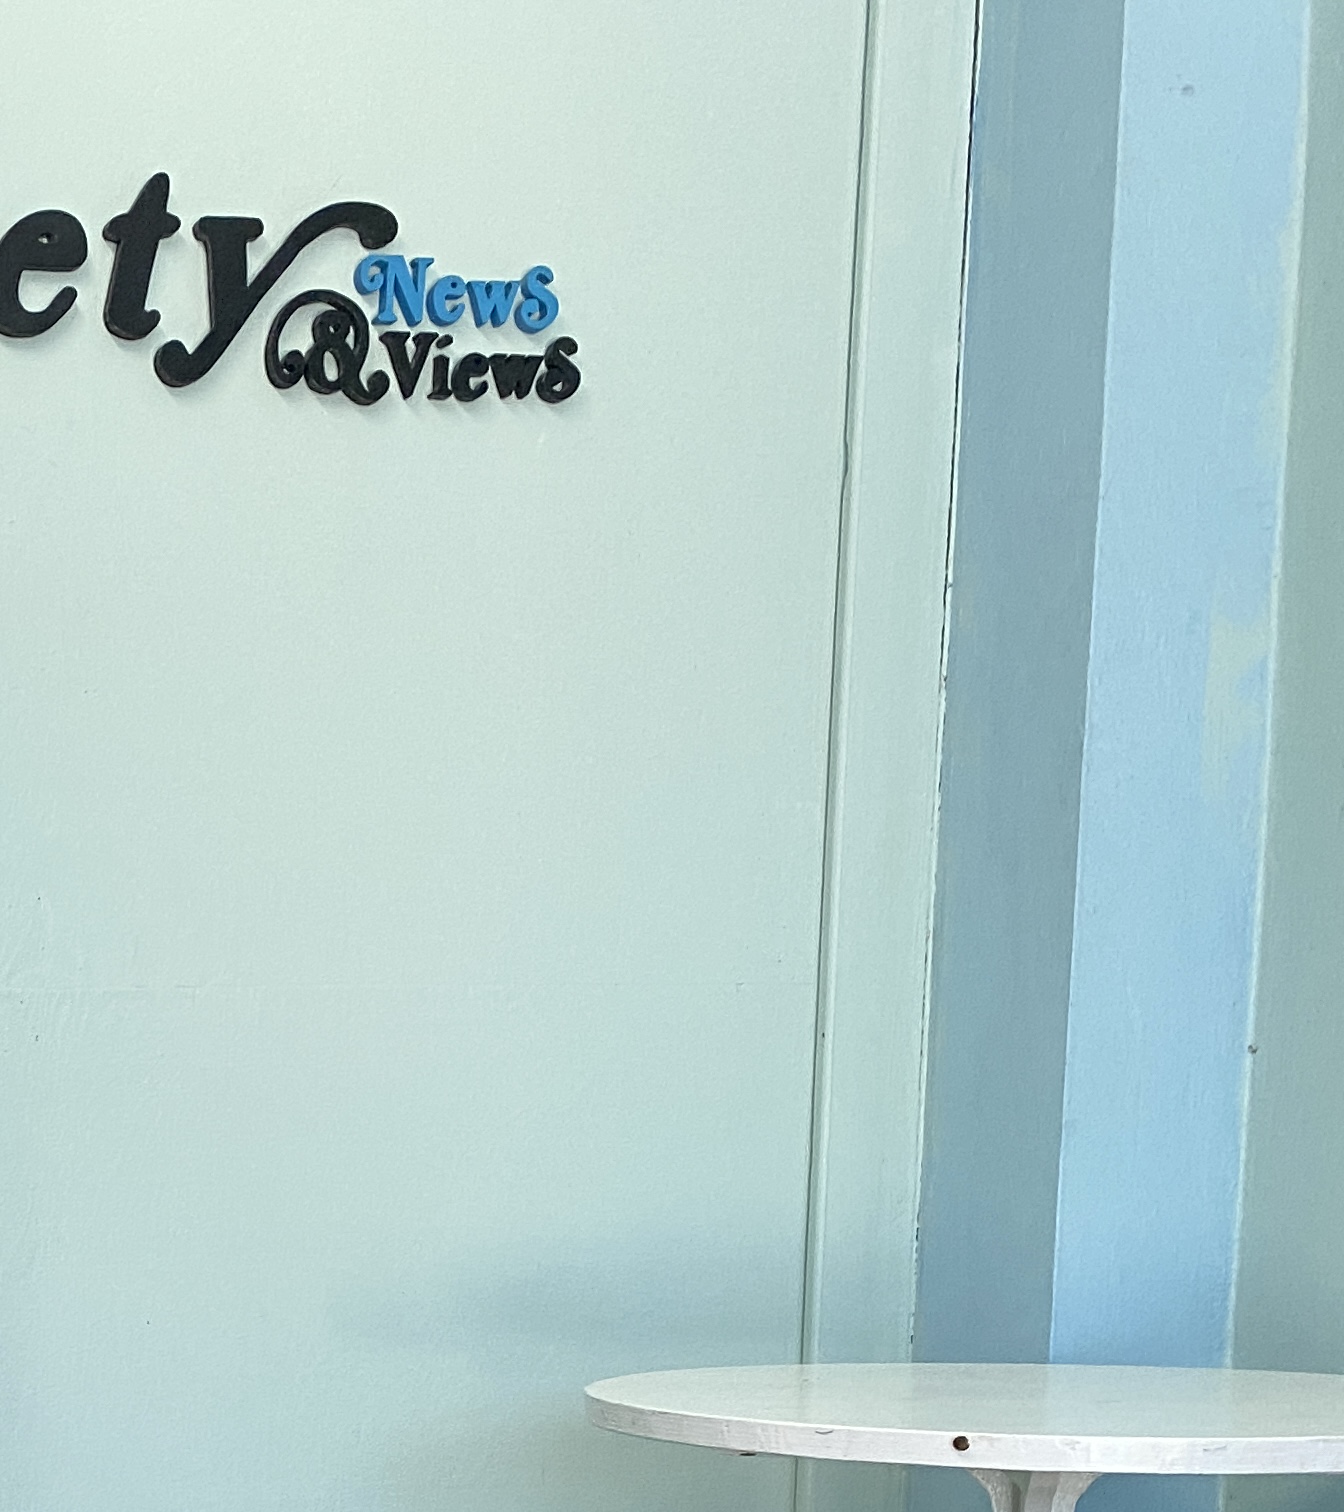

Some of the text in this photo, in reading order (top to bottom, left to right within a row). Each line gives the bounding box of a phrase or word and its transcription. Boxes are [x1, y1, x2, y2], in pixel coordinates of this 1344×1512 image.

[354, 255, 559, 334] News
[265, 289, 581, 405] & Views
